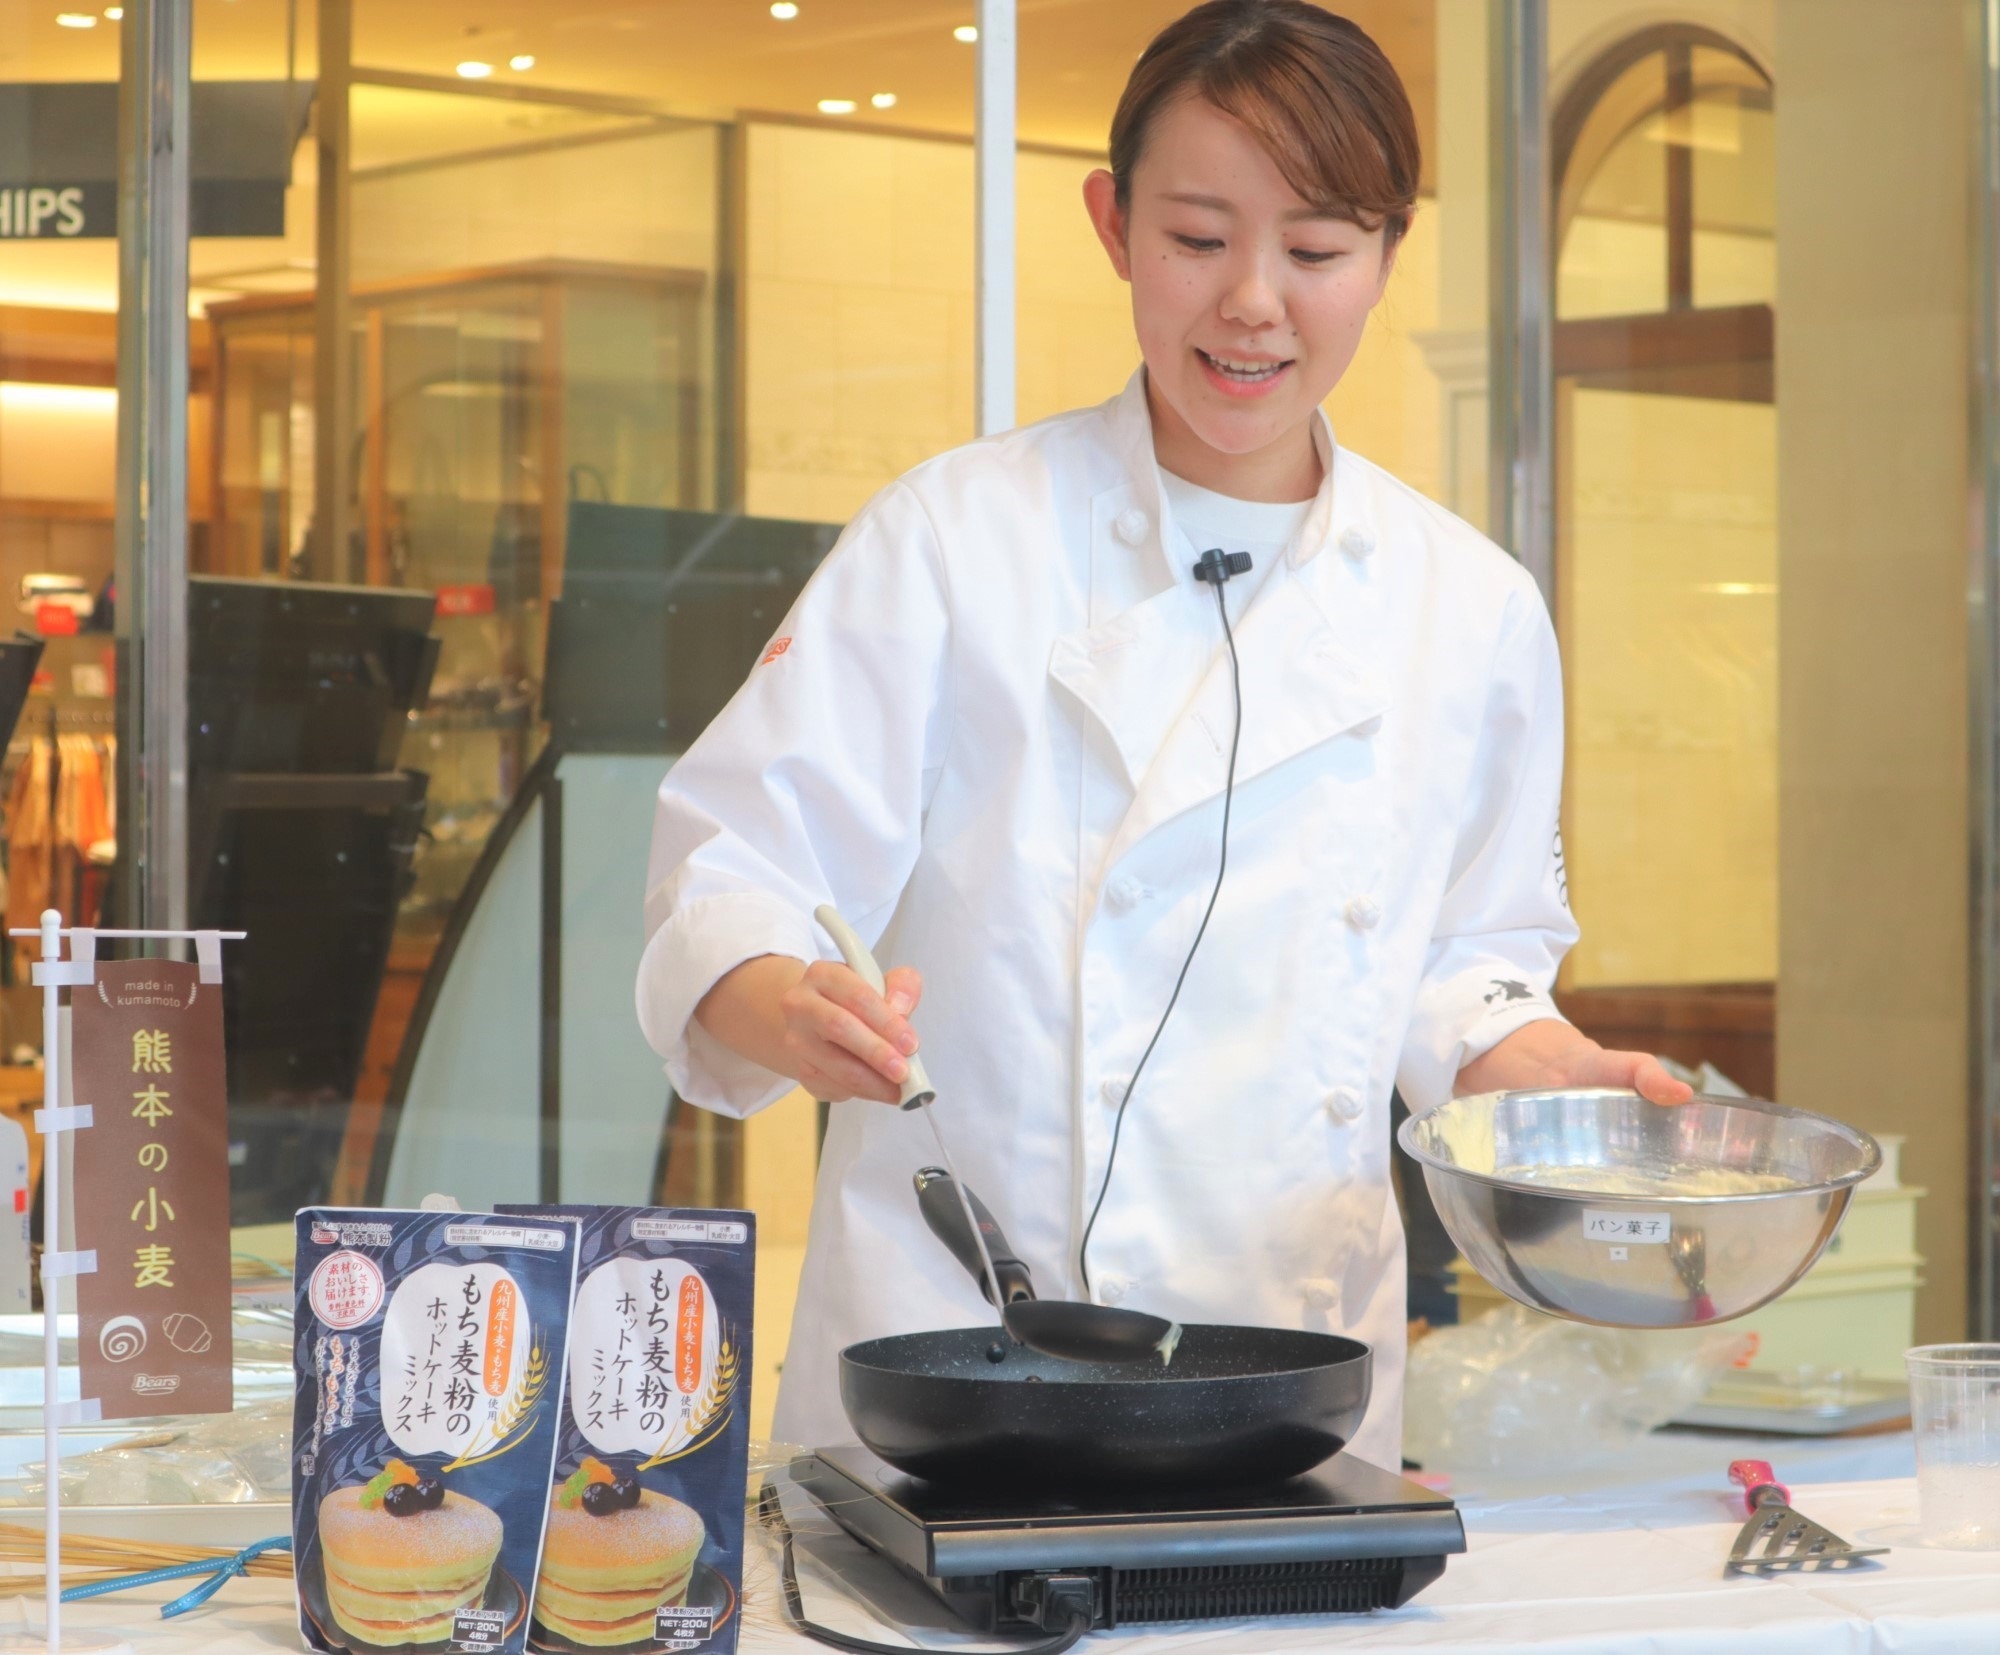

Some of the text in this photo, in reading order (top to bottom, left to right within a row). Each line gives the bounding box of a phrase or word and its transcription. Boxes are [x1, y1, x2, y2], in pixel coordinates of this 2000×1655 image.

[125, 979, 174, 992] made in
[117, 995, 181, 1008] kumamoto
[130, 1028, 176, 1289] 熊本の小麦
[1590, 1219, 1662, 1236] パン菓子
[342, 1231, 392, 1246] 熊本製粉
[328, 1260, 363, 1275] 素材の
[325, 1273, 368, 1287] おいしさ
[325, 1286, 369, 1300] 届けます
[443, 1273, 483, 1436] もち麦粉の
[608, 1292, 638, 1422] ホットケーキ
[635, 1269, 674, 1435] もち麦粉の
[416, 1297, 449, 1424] ホットケーキ
[134, 1374, 179, 1389] Bears
[341, 1336, 360, 1428] もち麦ならではの
[585, 1347, 607, 1430] ミックス
[393, 1354, 418, 1433] ミックス
[468, 1631, 489, 1641] 4枚分
[673, 1628, 695, 1638] 4枚分
